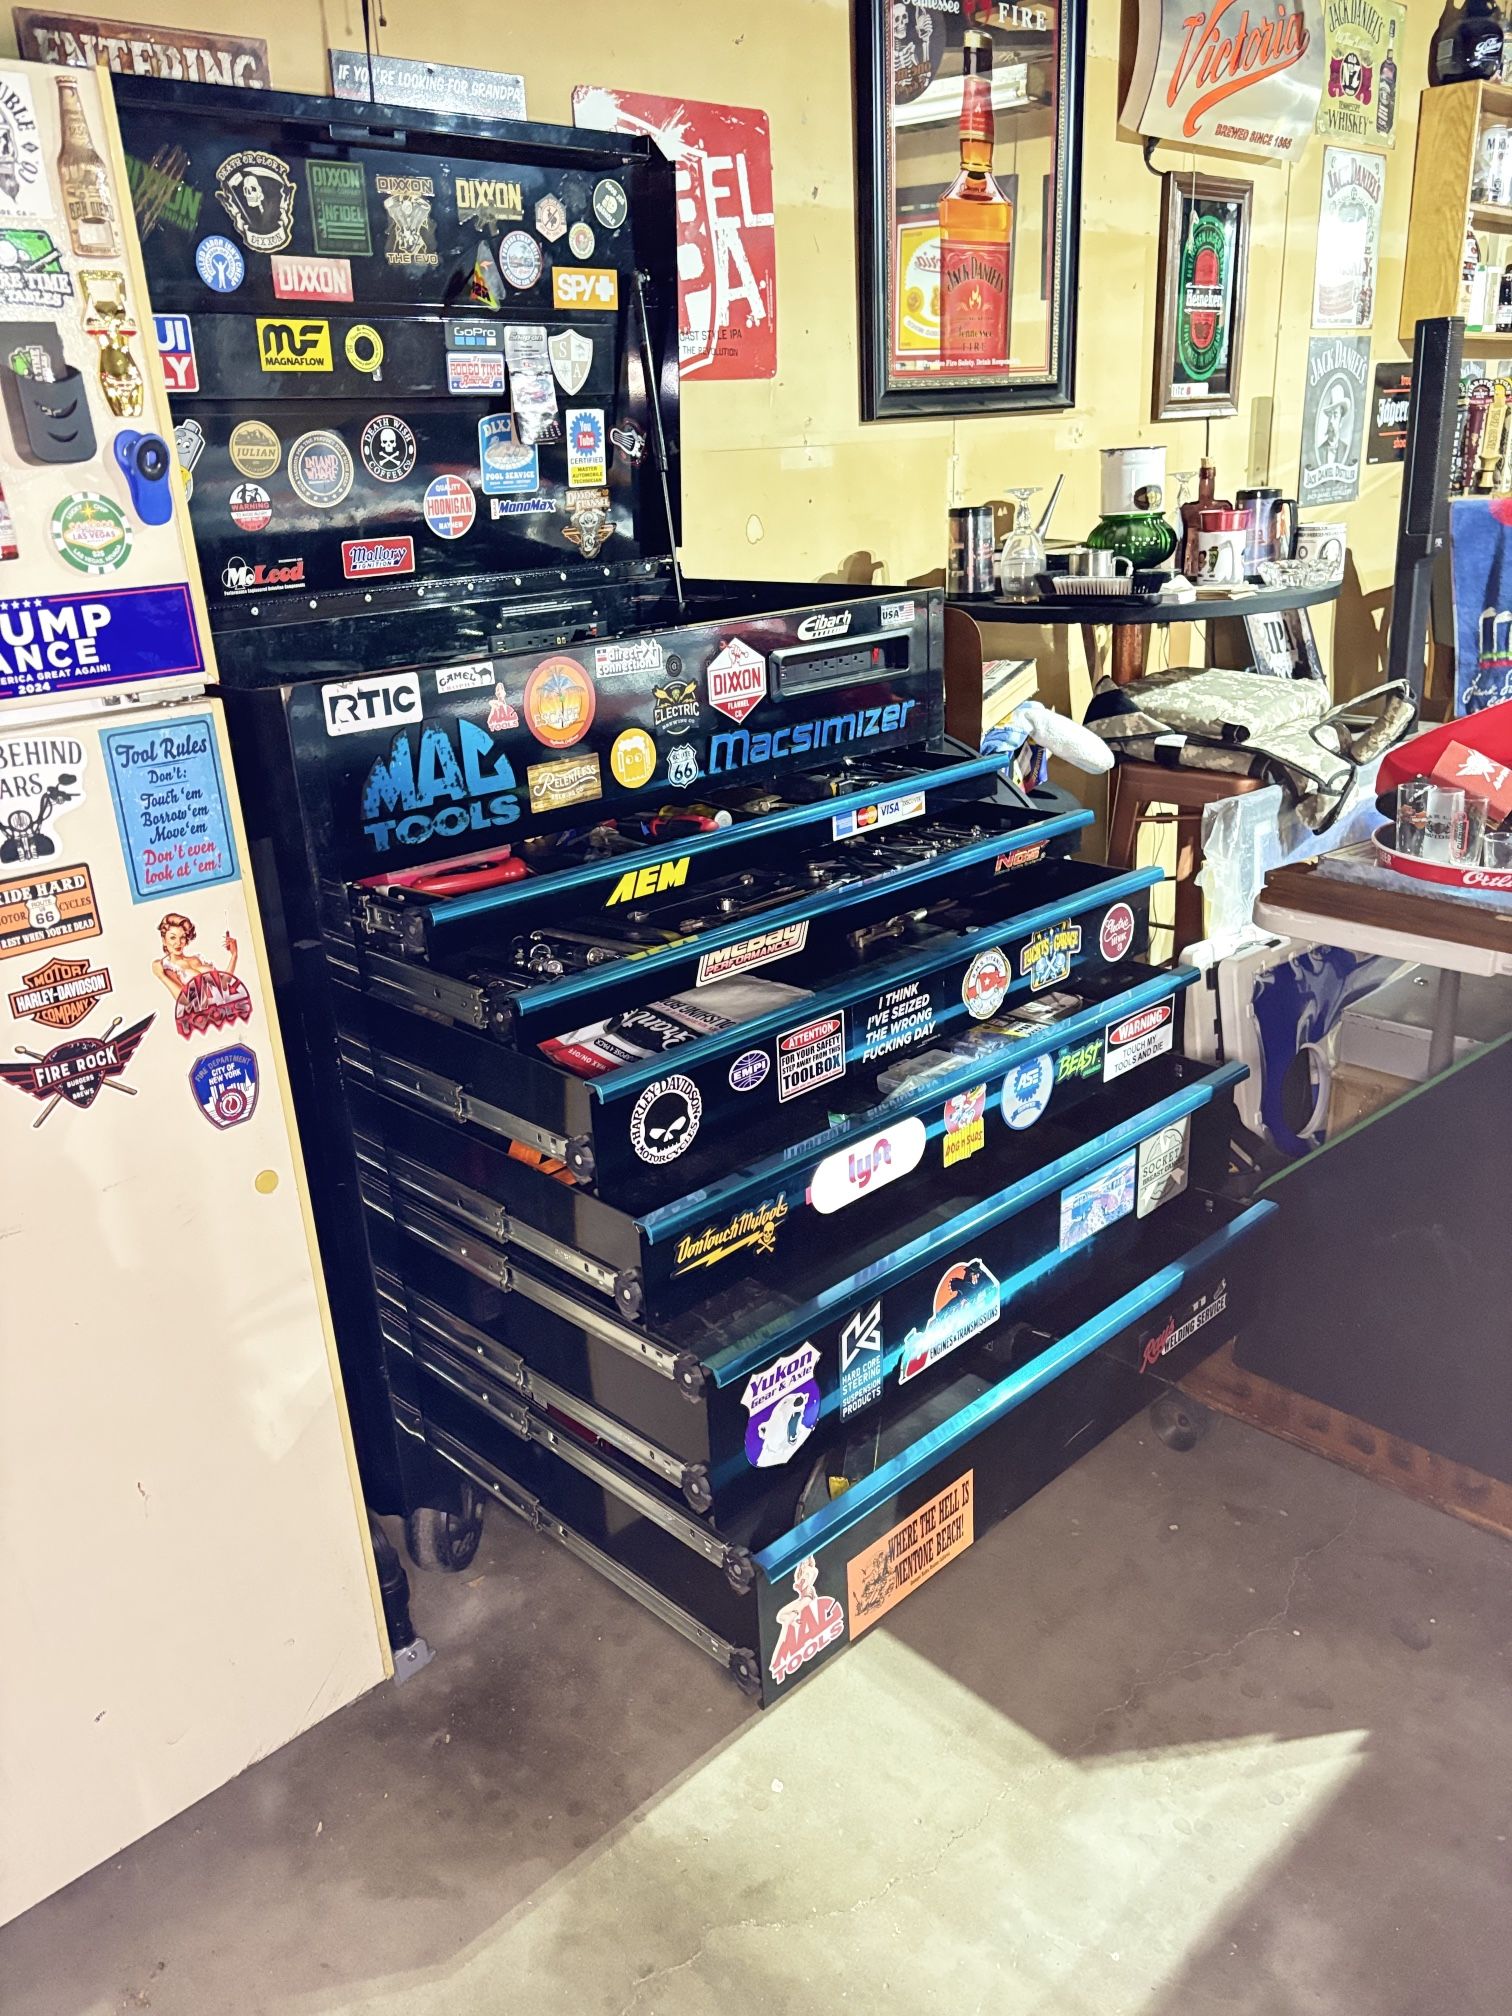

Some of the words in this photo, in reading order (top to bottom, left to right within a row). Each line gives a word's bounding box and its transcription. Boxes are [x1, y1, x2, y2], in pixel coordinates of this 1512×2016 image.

[998, 2, 1047, 32] FIRE
[1329, 0, 1349, 32] JACK
[33, 28, 264, 89] ENTERING
[1167, 0, 1310, 108] Victoria
[338, 64, 350, 80] IF
[398, 71, 443, 91] LOOKING
[446, 79, 467, 95] FOR
[471, 84, 521, 101] GRANDPA
[1215, 123, 1249, 141] BREWED
[1250, 131, 1274, 145] SINCE
[1328, 109, 1369, 135] WHISKEY
[218, 159, 242, 180] DEATH
[242, 156, 255, 165] OR
[256, 156, 286, 175] GLORY
[312, 166, 360, 188] DIXXON
[377, 177, 434, 194] DIXXON
[455, 179, 523, 212] DIXXON
[387, 252, 411, 264] THE
[414, 253, 438, 265] EVO
[278, 264, 347, 294] DIXXON
[947, 264, 970, 293] JACK
[1186, 288, 1223, 308] Heineken
[454, 327, 496, 337] GoPro
[958, 327, 993, 338] Tennessee
[265, 357, 324, 367] MAGNAFLOW
[559, 342, 567, 357] S
[1310, 348, 1335, 386] JACK
[1335, 340, 1367, 385] DANIEL'S
[450, 363, 480, 375] RODEO
[480, 363, 502, 375] TIME
[573, 367, 582, 378] A
[365, 418, 390, 441] DEATH
[237, 447, 276, 458] JULIAN
[232, 502, 269, 511] WARNING
[427, 498, 472, 516] HOONIGAN
[499, 500, 555, 513] MonoMax
[0, 604, 111, 646] UMP
[797, 610, 852, 640] Eibach
[882, 609, 900, 620] USA
[37, 668, 71, 681] GREAT
[75, 664, 111, 675] AGAIN!
[439, 674, 476, 686] CAMEL
[713, 667, 761, 696] DIXXON
[18, 682, 51, 695] 2024
[330, 685, 416, 725] RTIC
[535, 707, 581, 728] ESCAPE
[655, 702, 700, 725] ELECTRIC
[728, 699, 749, 710] FLANNEL
[115, 744, 158, 768] Tool
[160, 735, 207, 759] Rules
[709, 701, 915, 774] Macsimizer
[0, 740, 82, 768] BEHIND
[147, 768, 187, 784] Don't:
[365, 717, 516, 820] MAC
[534, 764, 597, 796] RELENTLESS
[674, 764, 692, 781] 66
[140, 788, 178, 809] Touch
[880, 802, 900, 816] VISA
[141, 808, 187, 827] Borrow
[364, 794, 520, 852] TOOLS
[150, 825, 185, 844] Move
[143, 843, 183, 866] Don't
[187, 840, 216, 856] even
[36, 876, 86, 896] HARD
[145, 866, 173, 885] look
[176, 865, 190, 879] at
[605, 857, 690, 907] AEM
[35, 911, 54, 925] 66
[59, 897, 91, 911] CYCLES
[1, 936, 21, 949] REST
[22, 931, 45, 945] WHEN
[46, 923, 72, 940] YOU'RE
[74, 920, 95, 933] DEAD
[1053, 930, 1079, 951] GARAGE
[705, 940, 797, 977] PERFORMANCE
[34, 964, 81, 987] MOTOR
[15, 974, 105, 1012] HARLEY-DAVIDSON
[179, 973, 249, 1016] MAC
[878, 997, 884, 1010] I
[885, 982, 920, 1006] THINK
[41, 999, 90, 1024] COMPANY
[180, 1002, 250, 1034] TOOLS
[867, 1009, 890, 1030] I'VE
[891, 994, 930, 1019] SEIZED
[1118, 1010, 1164, 1040] WARNING
[788, 1021, 834, 1047] ATTENTION
[866, 1026, 889, 1046] THE
[890, 1008, 932, 1035] WRONG
[782, 1054, 795, 1067] FOR
[796, 1048, 814, 1063] YOUR
[816, 1036, 840, 1055] SAFETY
[862, 1032, 912, 1063] FUCKING
[914, 1021, 936, 1041] DAY
[1123, 1040, 1146, 1058] TOUCH
[1147, 1034, 1157, 1045] MY
[35, 1062, 71, 1086] FIRE
[77, 1045, 117, 1070] ROCK
[195, 1066, 208, 1082] FIRE
[207, 1055, 251, 1070] DEPARTMENT
[211, 1065, 225, 1076] CITY
[226, 1062, 235, 1071] OF
[733, 1060, 767, 1081] EMPI
[782, 1064, 796, 1075] STEP
[796, 1058, 812, 1071] AWAY
[813, 1053, 827, 1064] FROM
[828, 1046, 841, 1057] THIS
[1115, 1054, 1137, 1073] TOOLS
[1138, 1048, 1152, 1063] AND
[1153, 1041, 1164, 1055] DIE
[66, 1074, 94, 1088] BURGERS
[208, 1075, 223, 1085] NEW
[224, 1068, 242, 1080] YORK
[783, 1054, 841, 1091] TOOLBOX
[72, 1088, 95, 1100] BREWS
[632, 1075, 701, 1139] HARLEY-DAVIDSON
[638, 1122, 698, 1165] MOTORCYCLES
[849, 1138, 891, 1188] lyft
[1142, 1148, 1180, 1178] SOCKET
[1164, 1320, 1195, 1352] WELDING
[1196, 1297, 1225, 1327] SERVICE
[750, 1350, 812, 1397] Yukon
[842, 1370, 861, 1384] HARD
[862, 1356, 881, 1371] CORE
[842, 1365, 881, 1395] STEERING
[751, 1390, 778, 1409] Gear
[789, 1366, 812, 1387] Axle
[842, 1378, 881, 1407] SUSPENSION
[842, 1388, 881, 1417] PRODUCTS
[888, 1521, 918, 1562] WHERE
[920, 1506, 936, 1538] THE
[939, 1489, 959, 1524] HELL
[962, 1480, 970, 1506] IS
[895, 1542, 933, 1589] MENTONE
[936, 1514, 964, 1556] BEACH!
[772, 1598, 842, 1669] MAC
[772, 1624, 843, 1684] TOOLS
